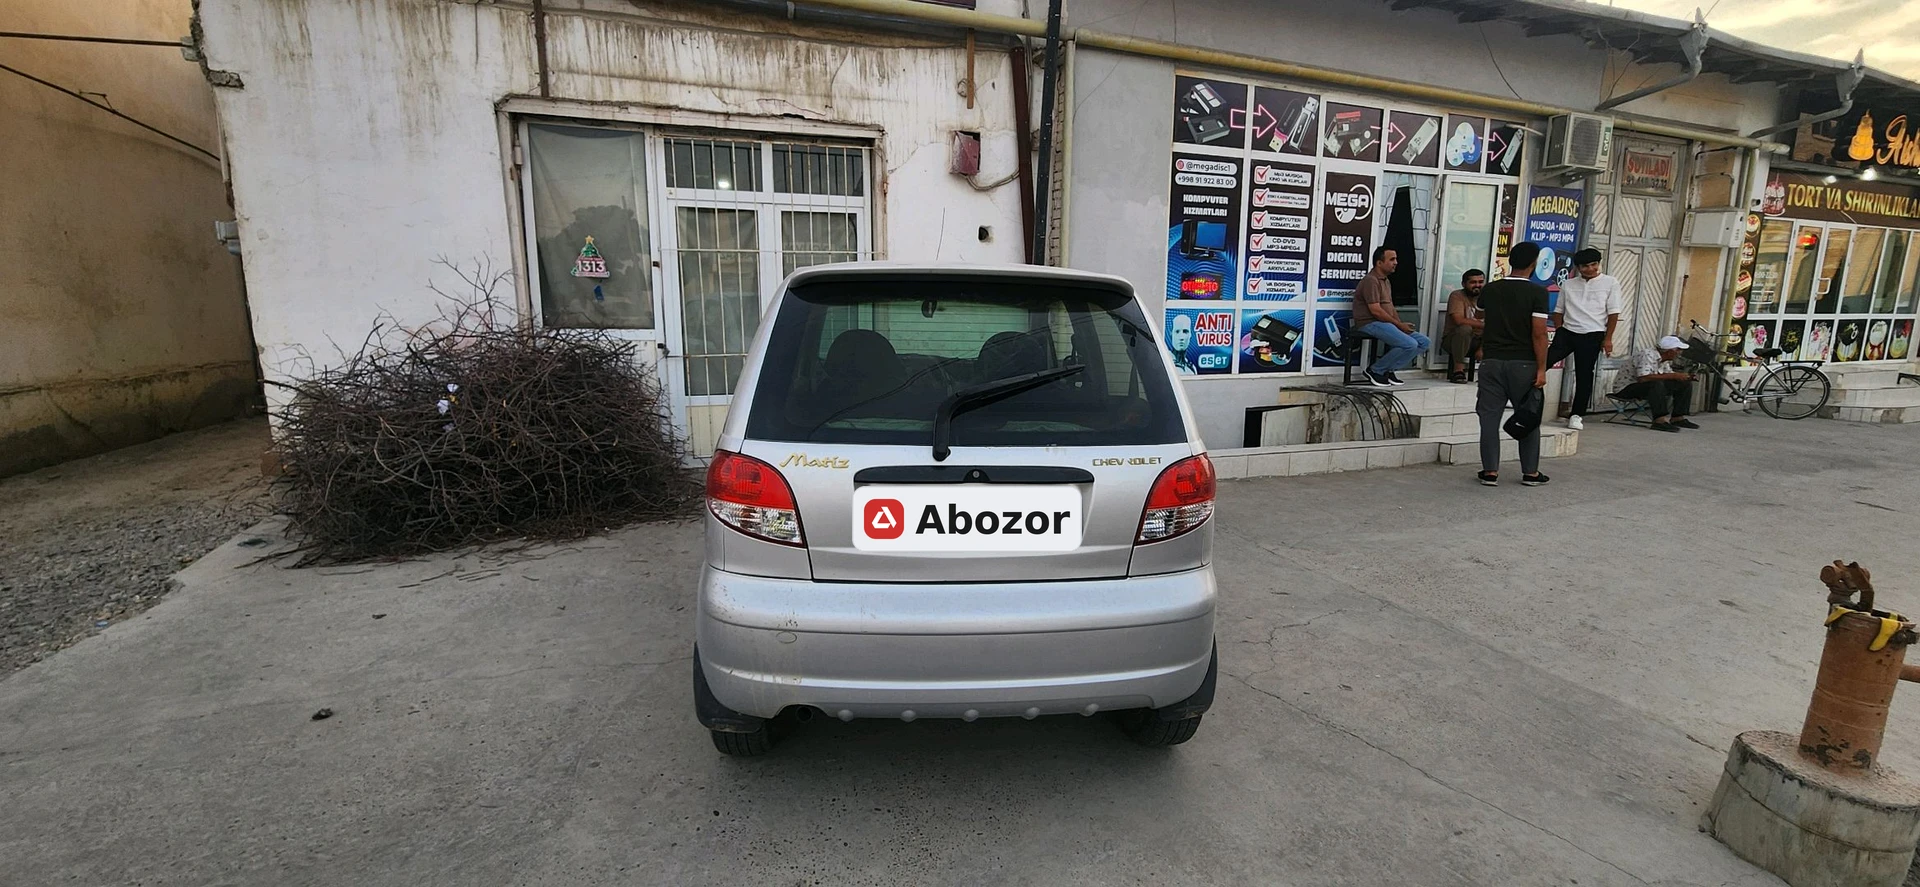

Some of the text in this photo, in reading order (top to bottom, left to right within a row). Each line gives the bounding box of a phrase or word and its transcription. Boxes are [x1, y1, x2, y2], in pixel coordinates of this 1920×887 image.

[1186, 162, 1231, 172] @megadisc1
[1183, 194, 1229, 205] KOMPYUTER
[1326, 192, 1370, 209] MEGA
[1787, 184, 1824, 208] TORT
[1826, 187, 1842, 210] VA
[1183, 206, 1228, 217] XIZMATLARI
[1530, 195, 1580, 219] MEGADISC
[1530, 220, 1575, 232] MUSIQA KINO
[1331, 235, 1362, 247] DISC &
[1531, 232, 1574, 243] KLIP MP3 MP4
[1327, 252, 1364, 264] DIGITAL
[577, 260, 605, 272] 1313
[1320, 268, 1367, 280] SERVICES
[1195, 313, 1233, 330] ANTI
[1197, 333, 1231, 346] VIRUS
[779, 453, 849, 469] Matiz
